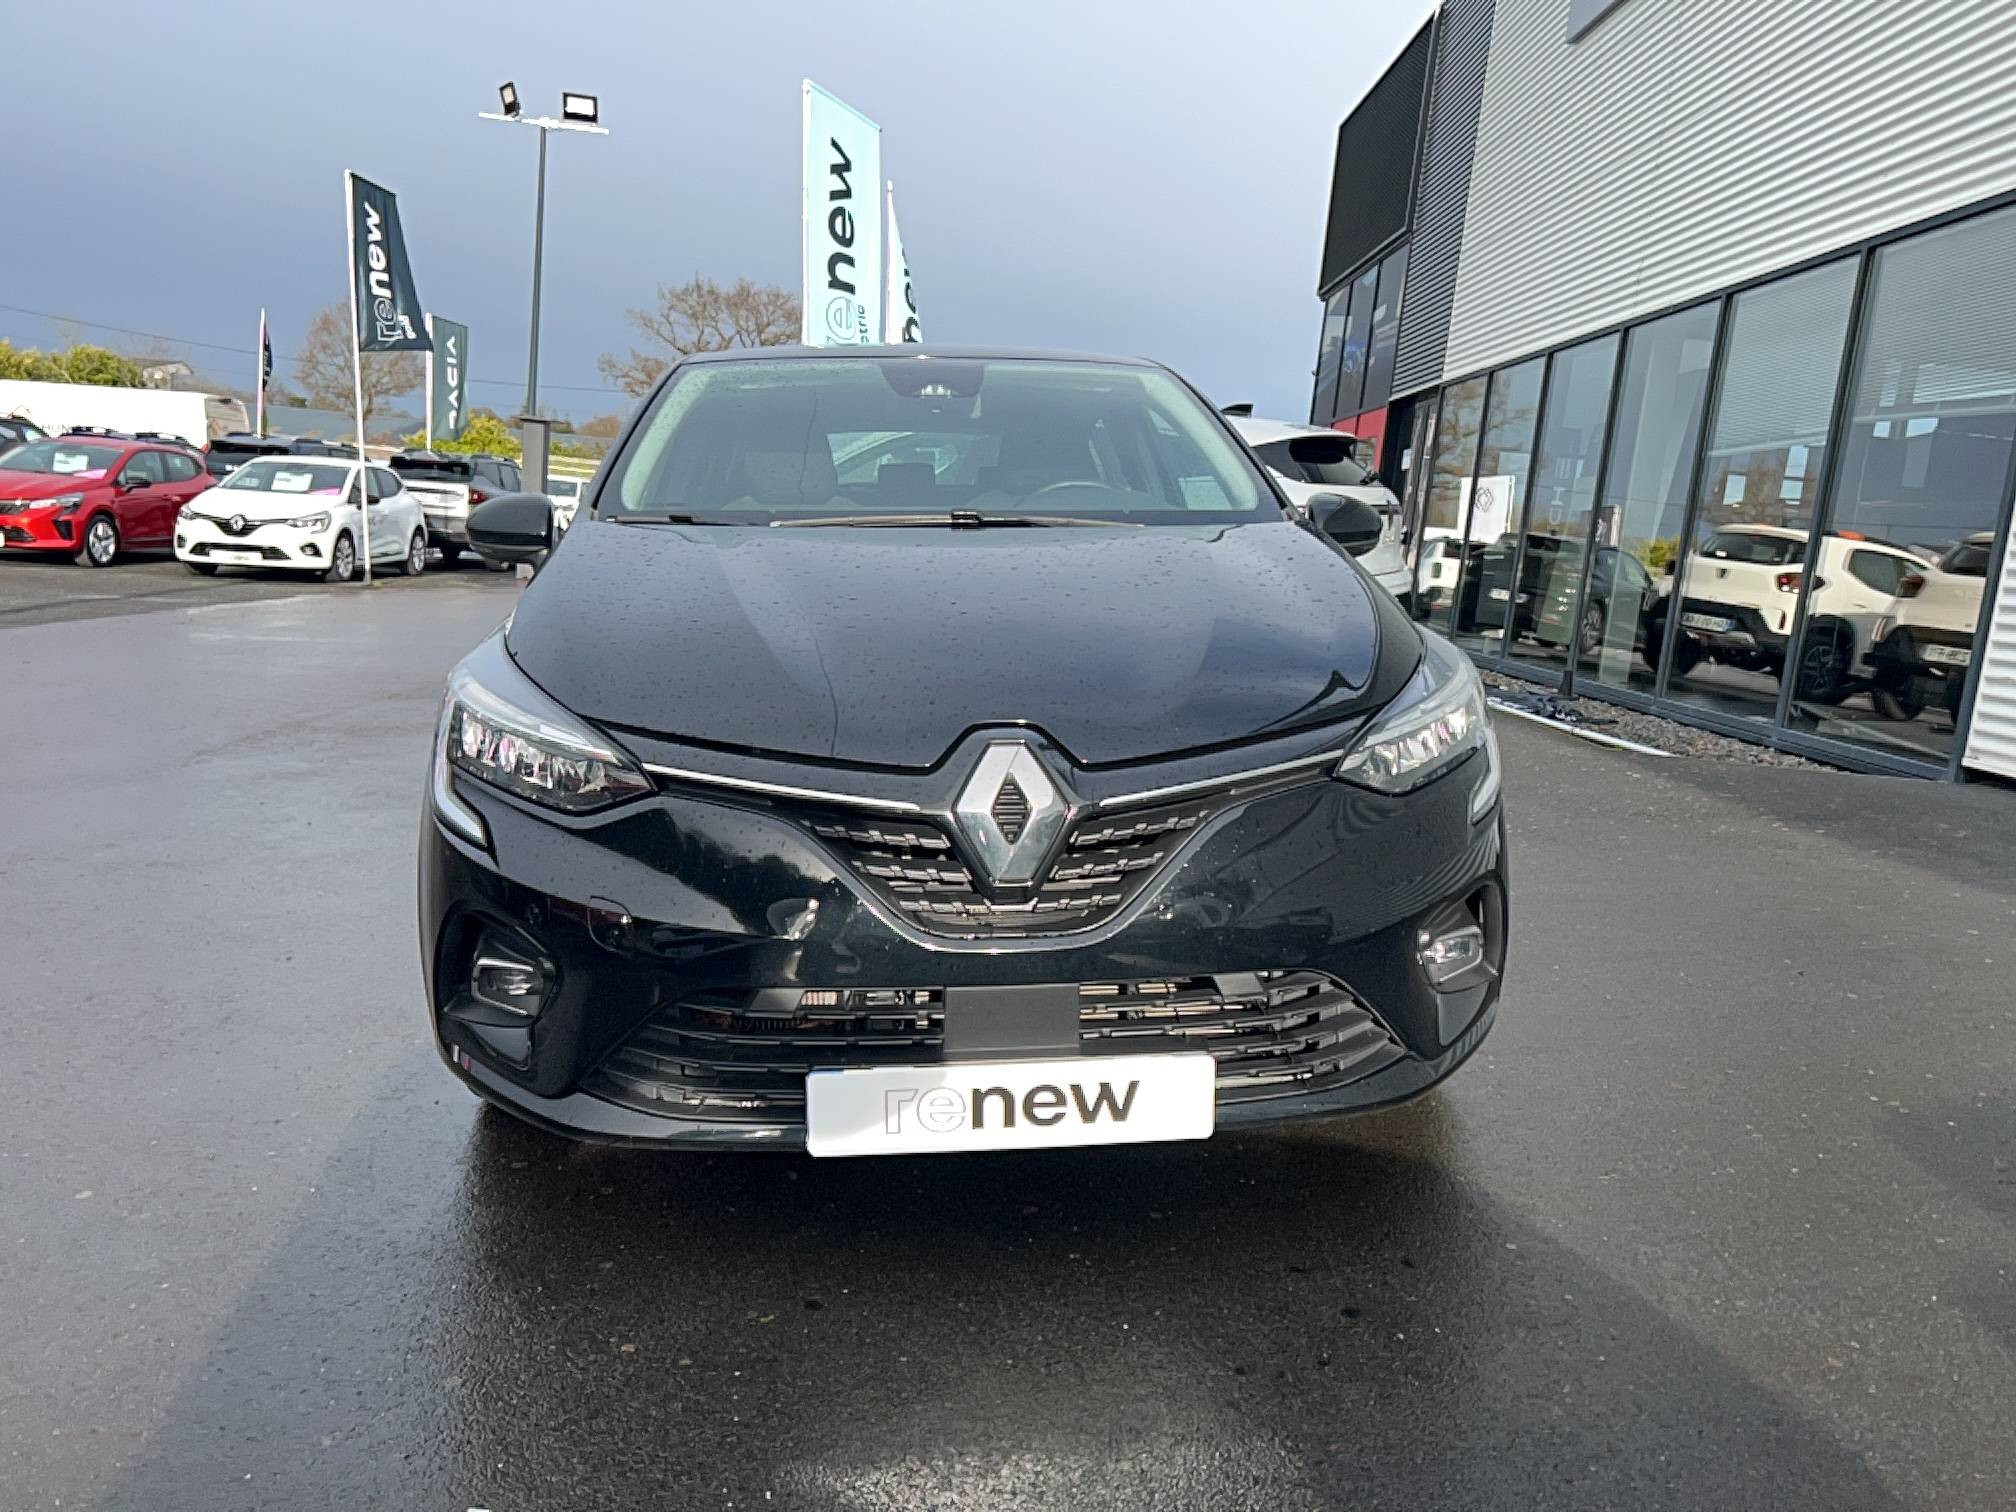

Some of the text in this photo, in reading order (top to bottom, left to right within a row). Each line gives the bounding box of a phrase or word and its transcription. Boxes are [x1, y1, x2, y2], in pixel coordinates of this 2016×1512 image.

[364, 201, 403, 342] renew
[445, 335, 460, 430] DACIA
[884, 1080, 1140, 1136] renew
